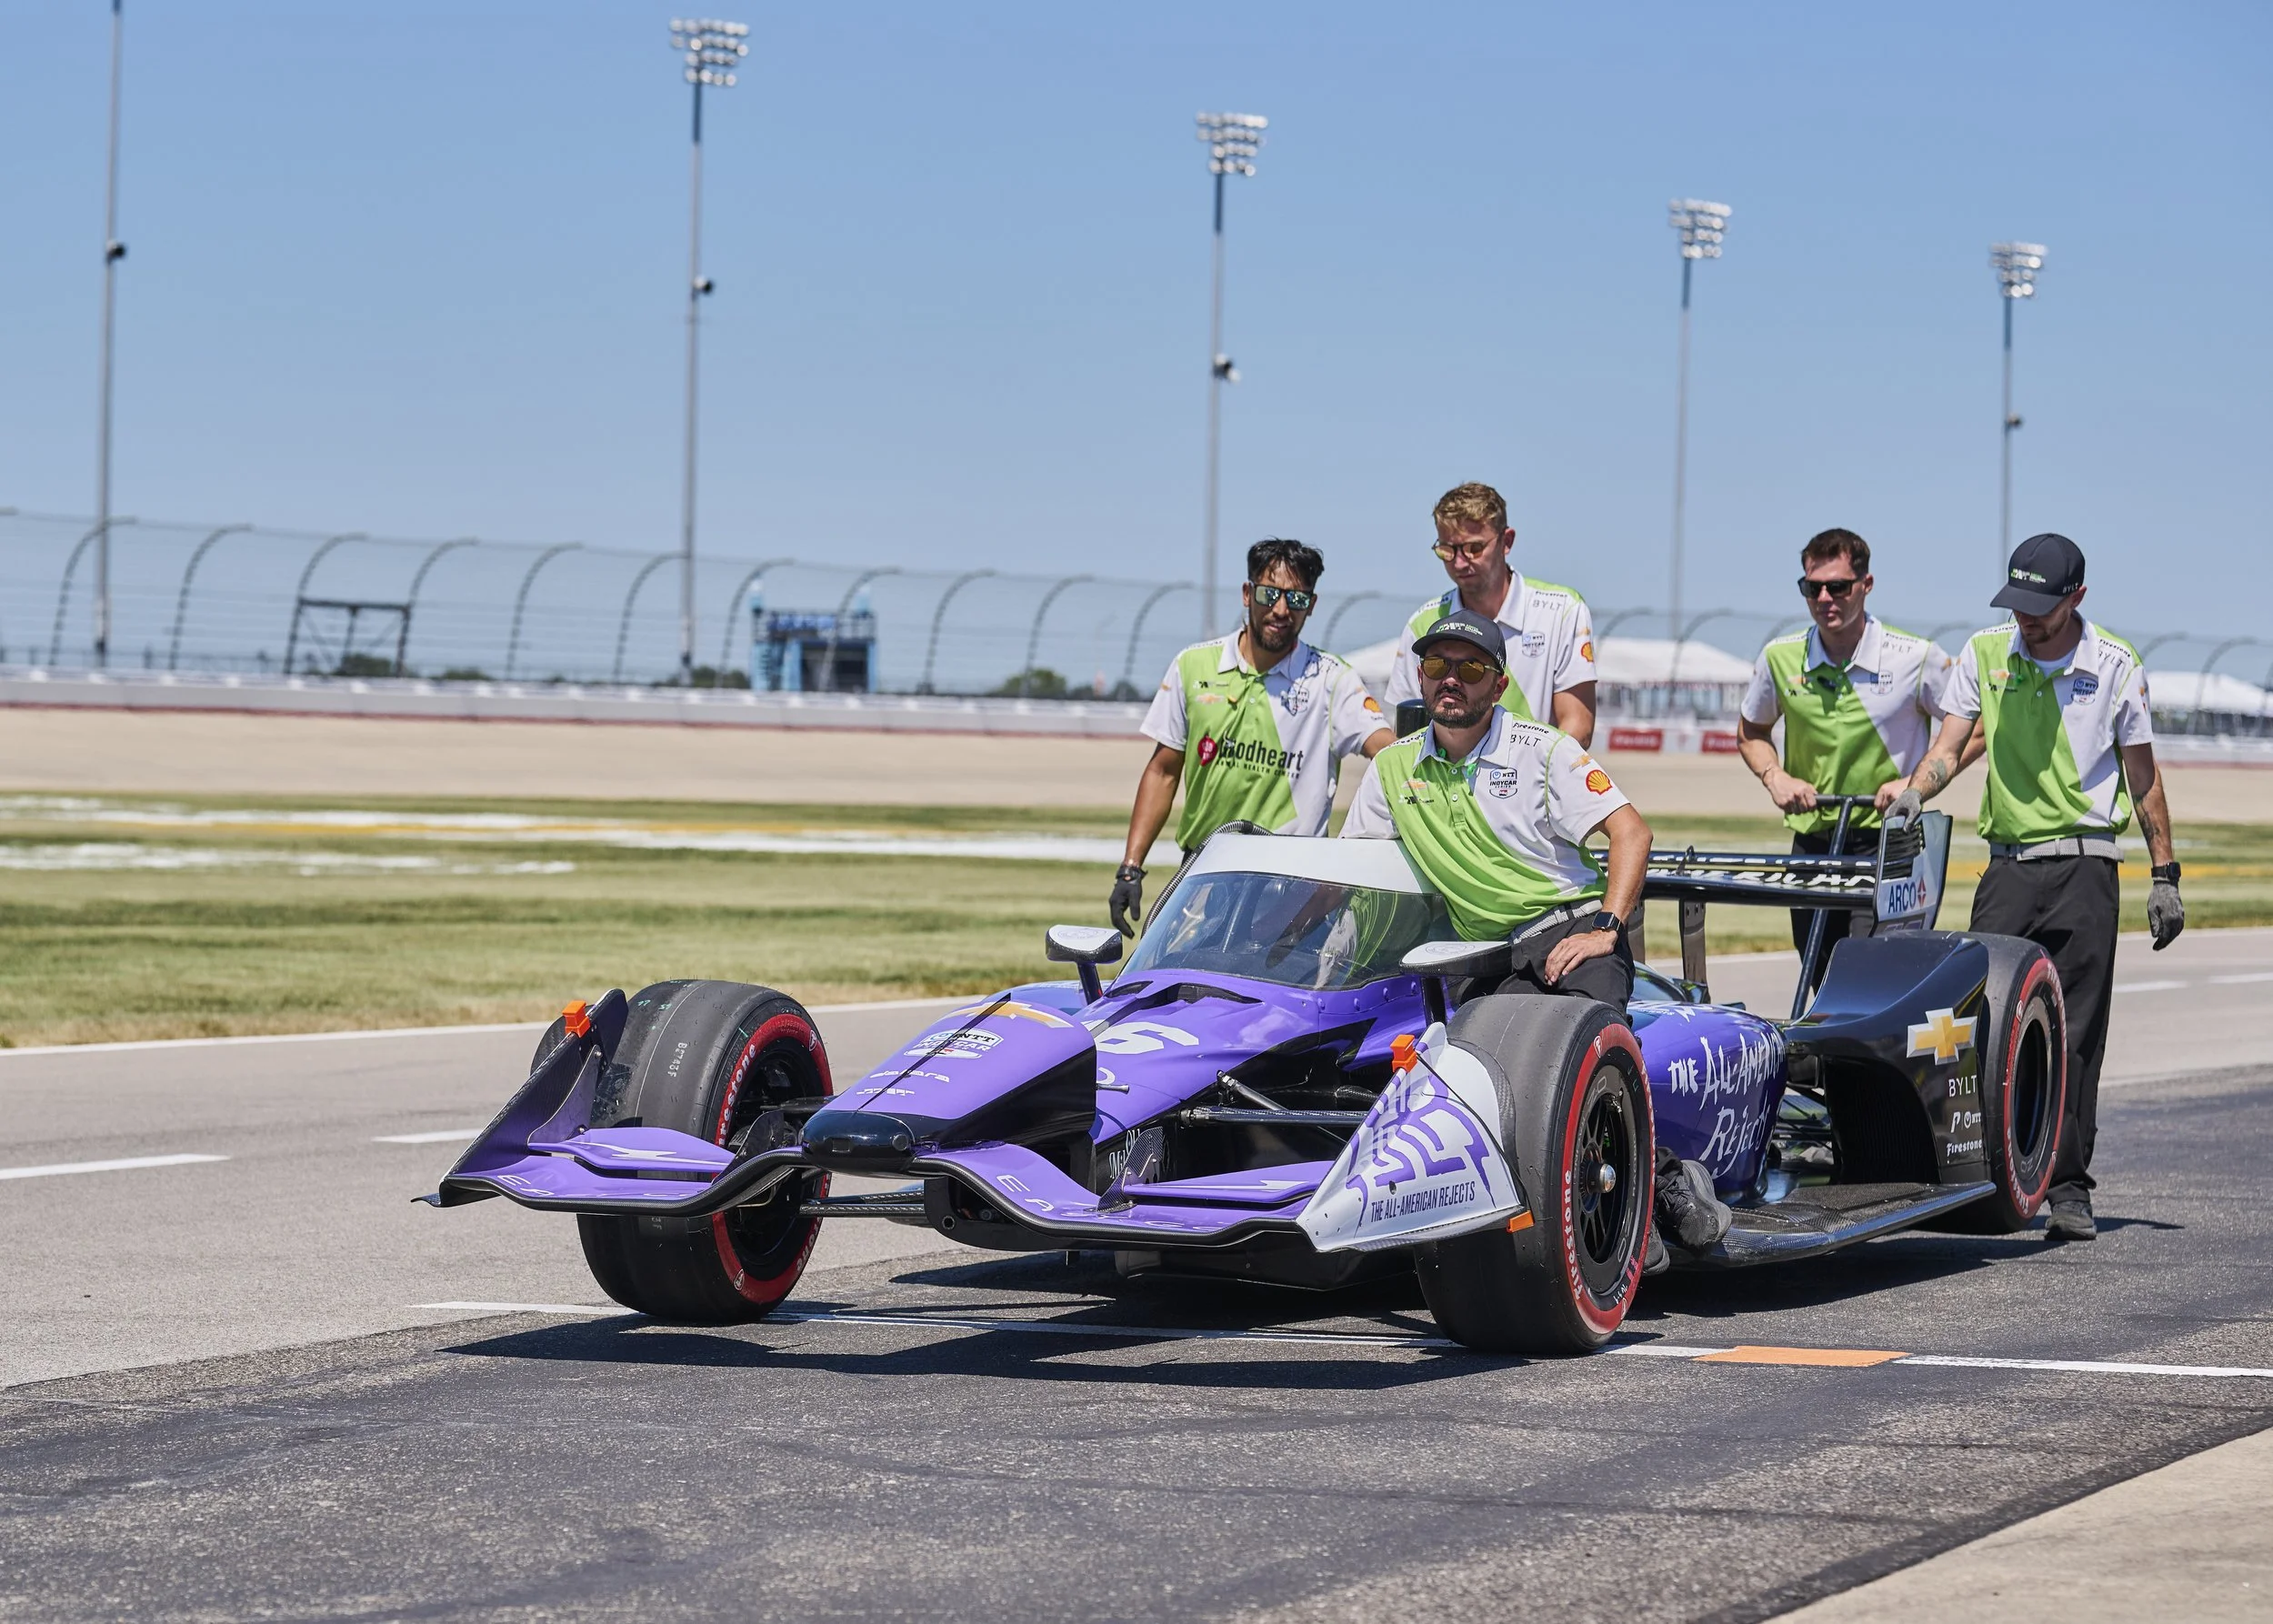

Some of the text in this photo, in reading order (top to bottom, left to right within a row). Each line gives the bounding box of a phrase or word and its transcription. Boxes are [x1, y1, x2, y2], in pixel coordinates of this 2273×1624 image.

[1533, 599, 1562, 611] BYLT
[1513, 722, 1549, 734] Firestone
[1888, 885, 1918, 913] ARCO
[1667, 1058, 1699, 1097] THE
[1948, 1075, 1978, 1098] BYLT
[718, 1044, 756, 1146] irestone
[1947, 1139, 1982, 1158] Firestone
[1371, 1180, 1476, 1223] THE ALL-AMERICAN REJECTS
[1564, 1170, 1584, 1299] Firestone
